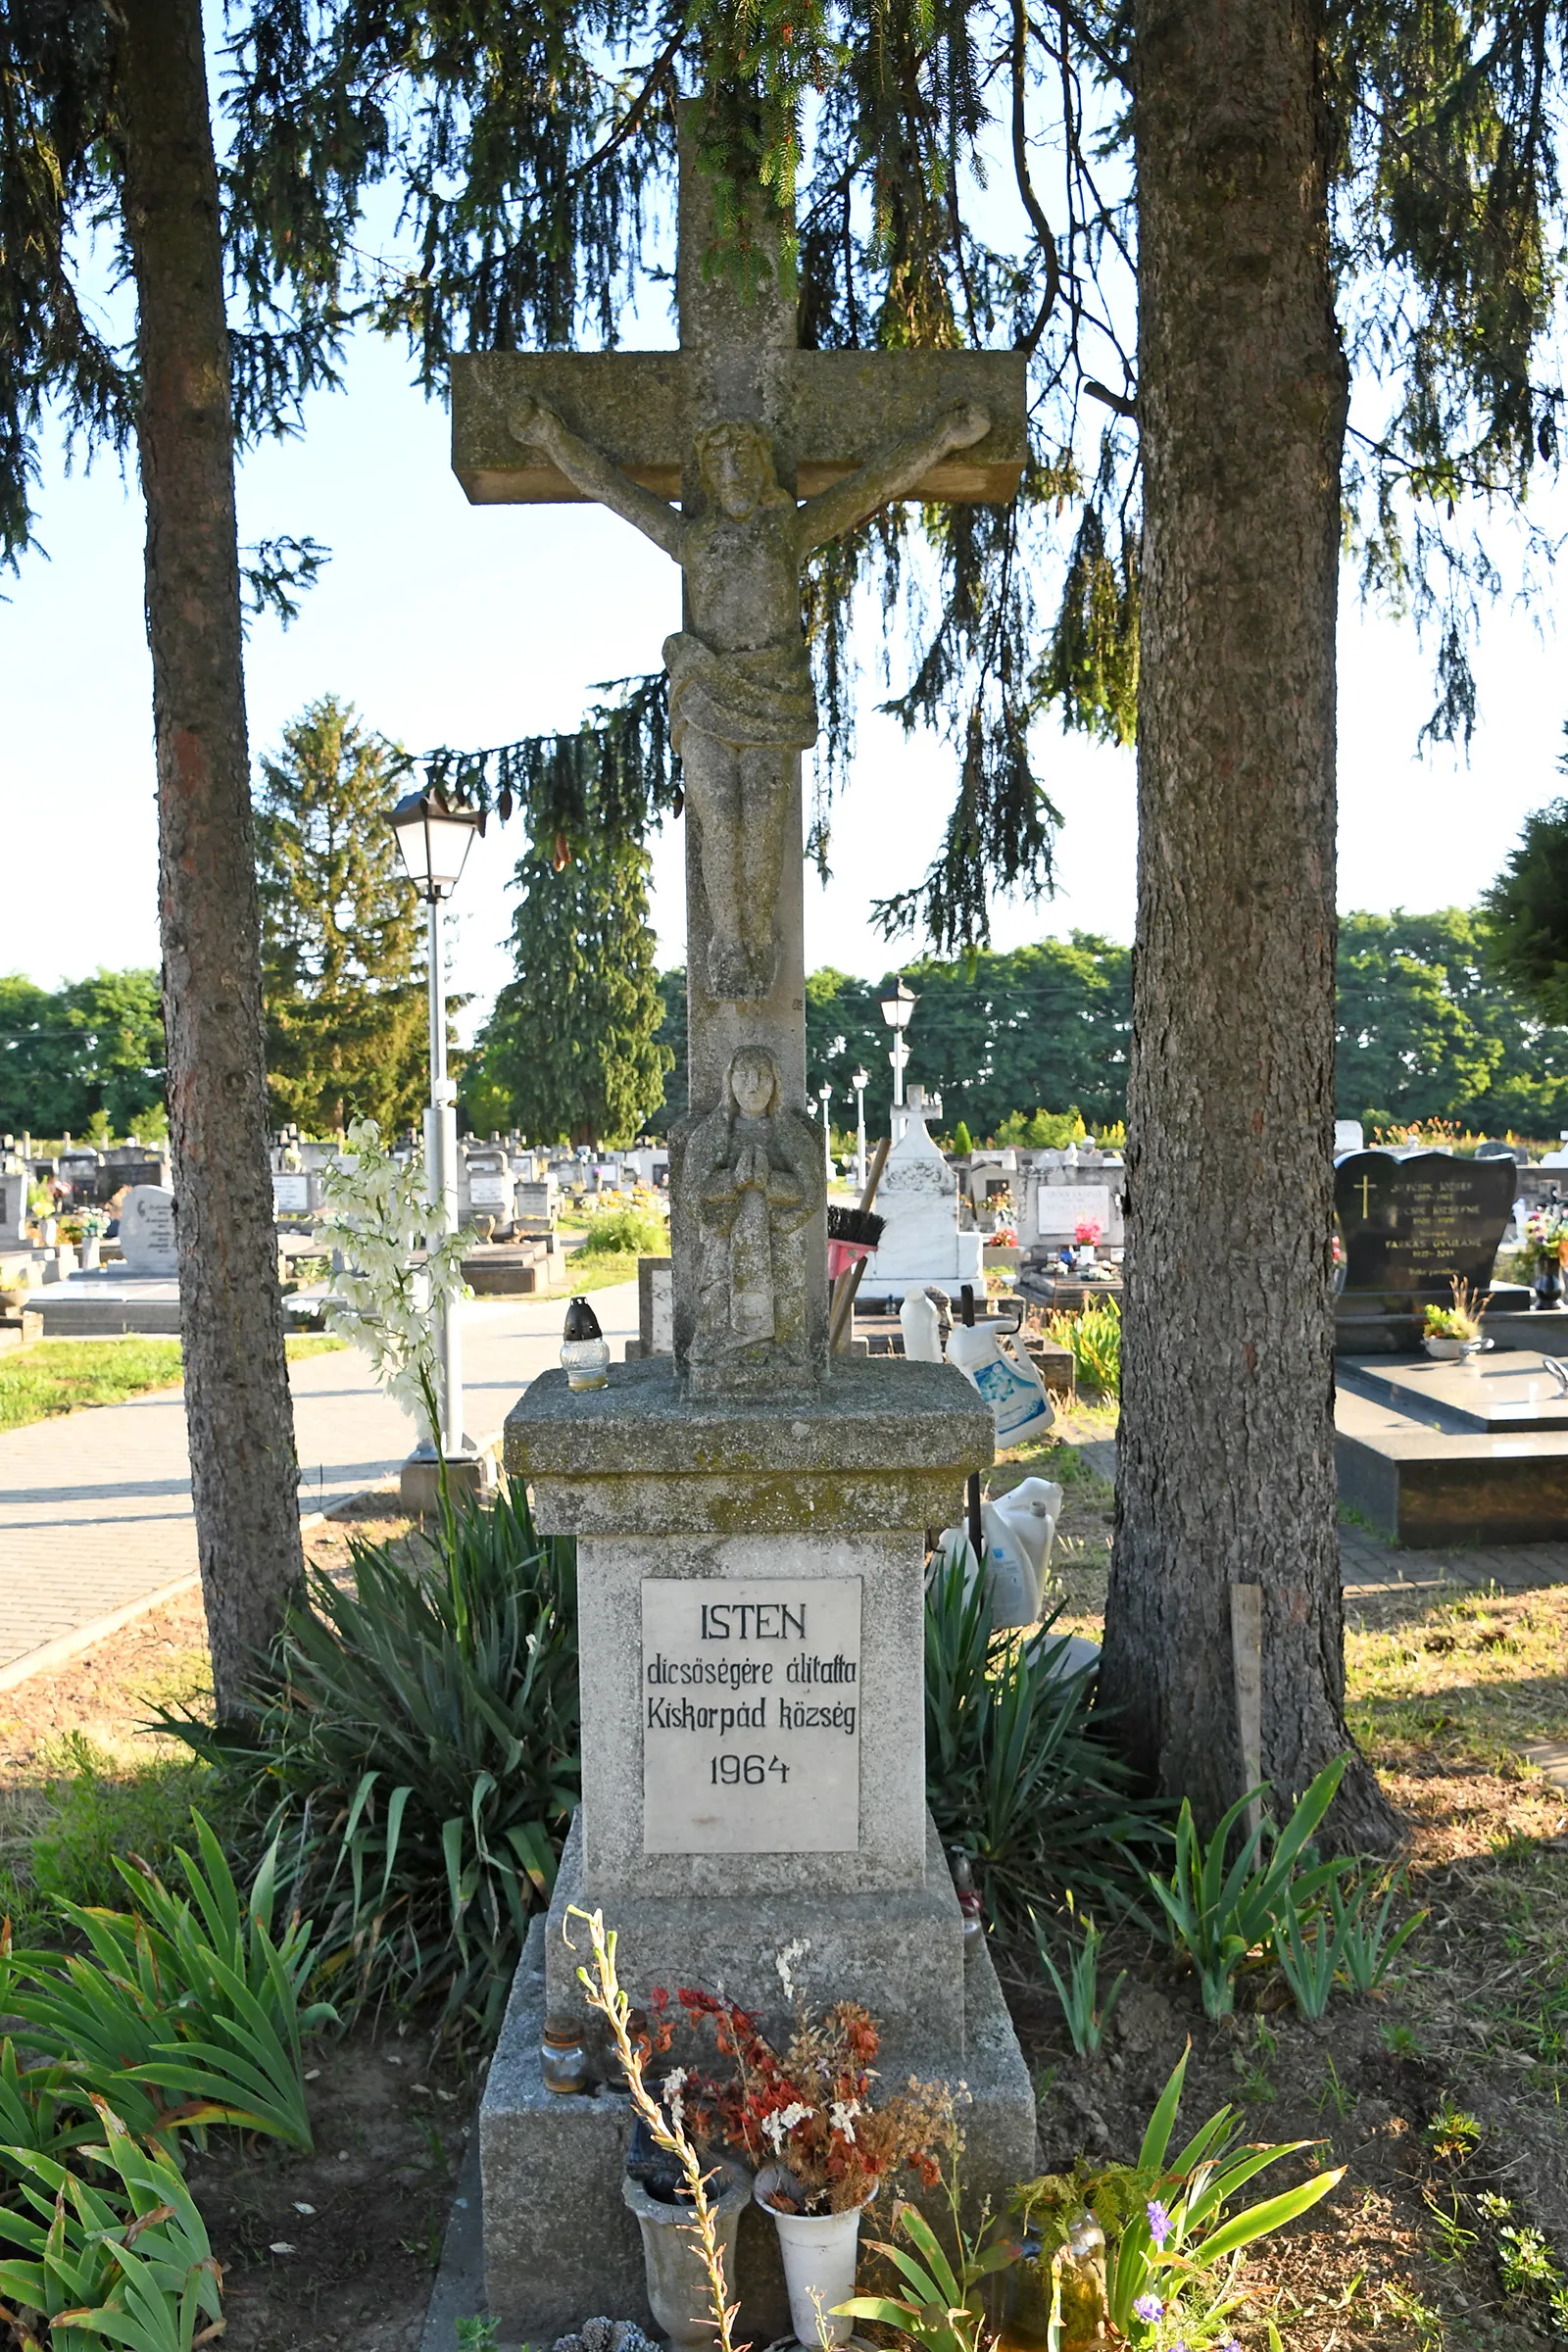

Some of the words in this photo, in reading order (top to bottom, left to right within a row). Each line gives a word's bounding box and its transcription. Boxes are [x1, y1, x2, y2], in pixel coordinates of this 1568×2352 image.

[701, 1603, 807, 1641] ISTEN
[647, 1652, 773, 1691] dicsőségére
[647, 1696, 766, 1737] Kiskorpád
[779, 1696, 857, 1736] község
[710, 1754, 791, 1786] 1964
